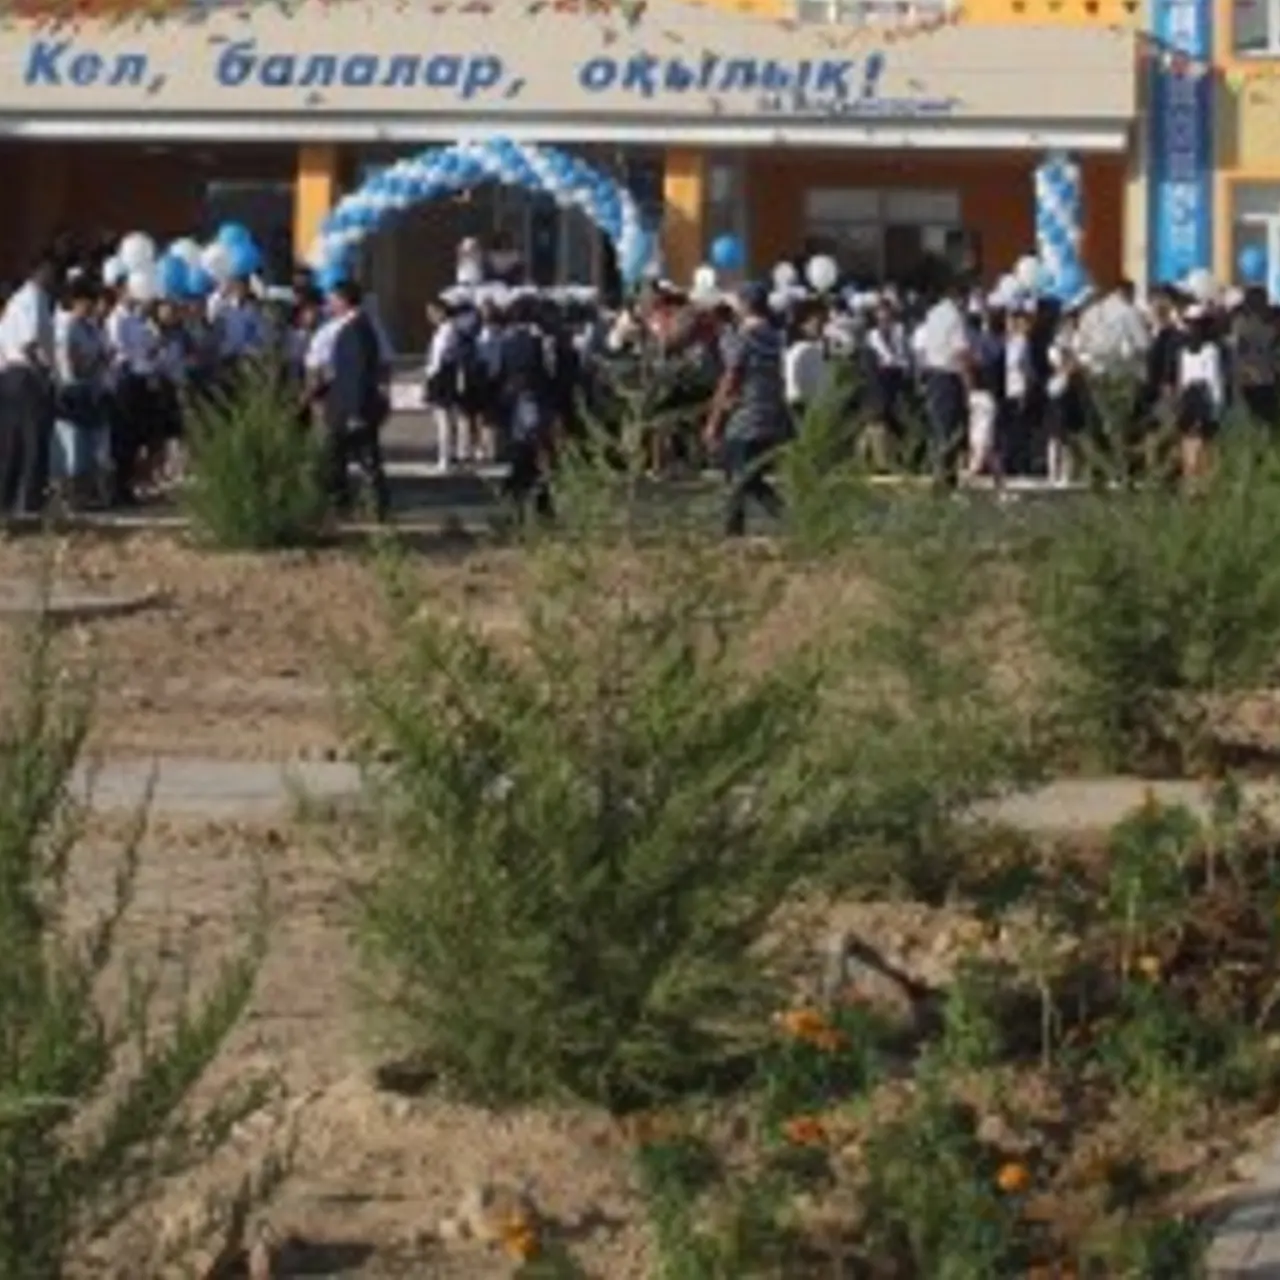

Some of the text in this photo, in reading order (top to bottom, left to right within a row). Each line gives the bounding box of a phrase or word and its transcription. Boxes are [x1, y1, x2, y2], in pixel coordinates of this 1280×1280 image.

[23, 38, 886, 100] Кел, балалар, оқылық!
